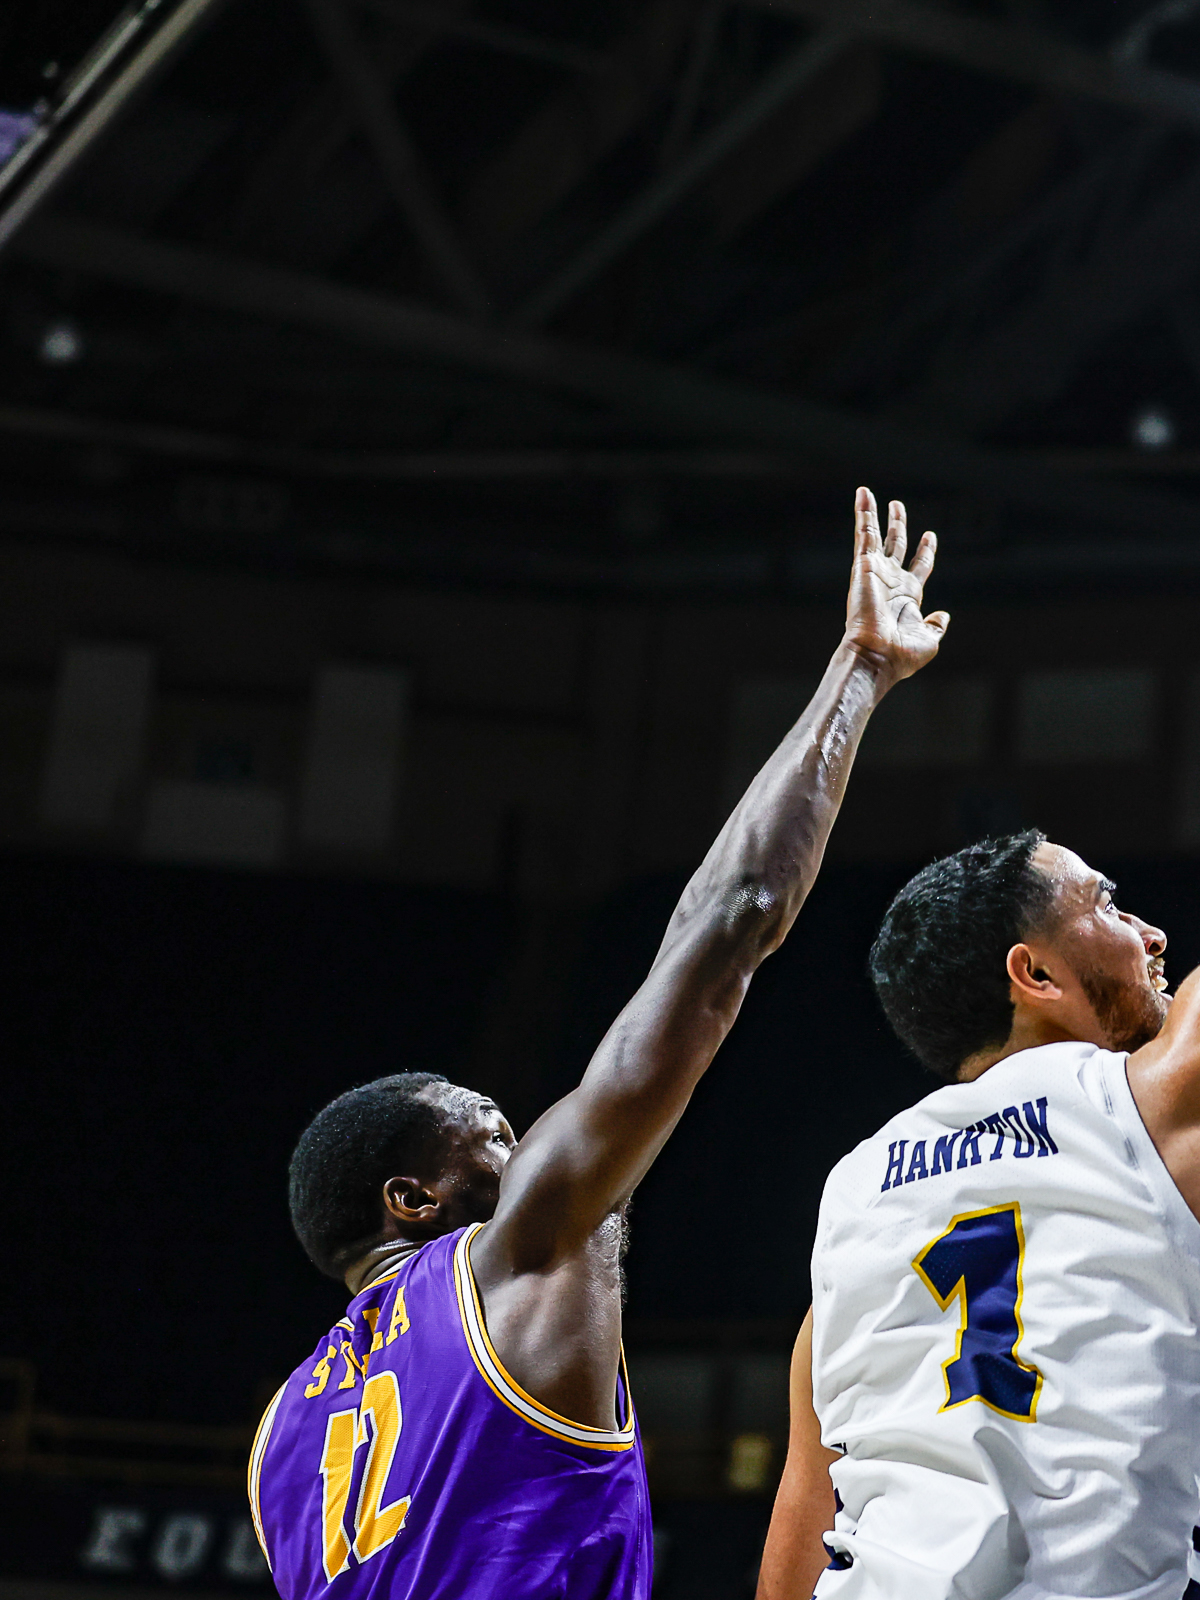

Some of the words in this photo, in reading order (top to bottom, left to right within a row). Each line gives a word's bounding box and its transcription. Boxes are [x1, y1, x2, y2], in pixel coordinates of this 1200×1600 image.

[880, 1096, 1059, 1193] HANKTON
[911, 1200, 1043, 1424] 1
[318, 1370, 412, 1584] 12
